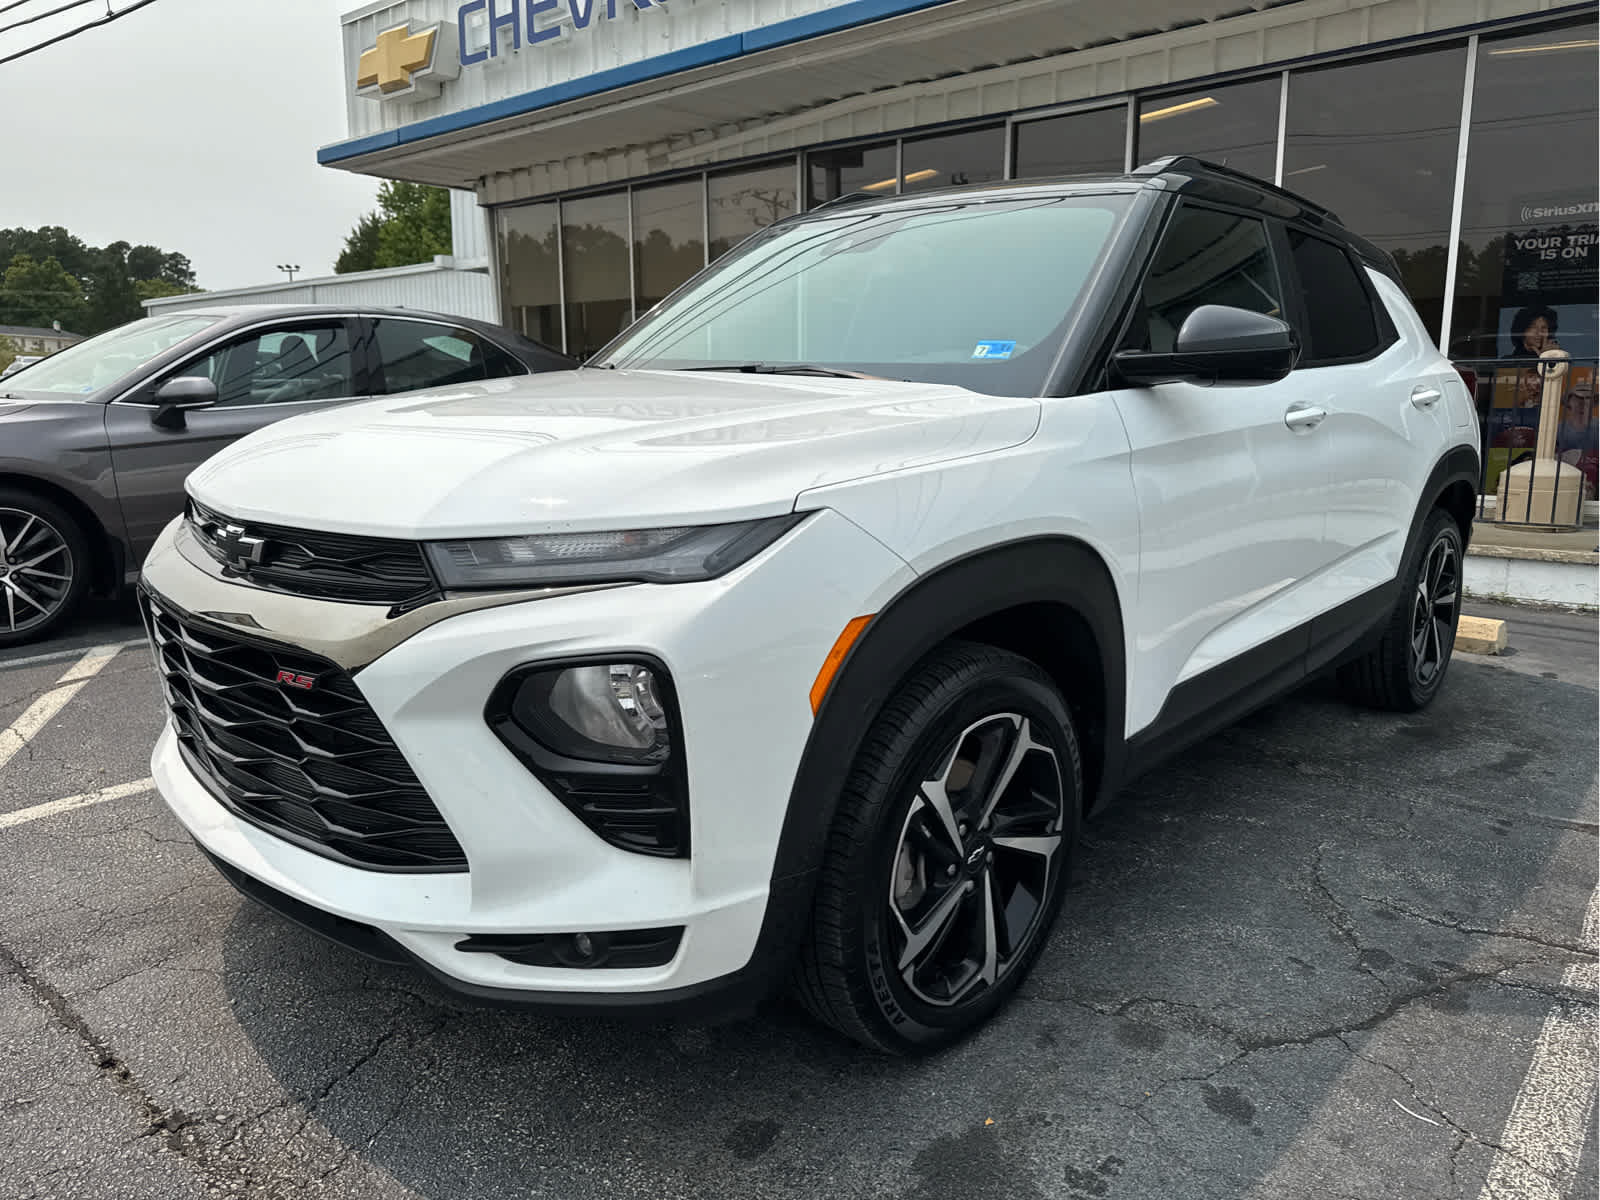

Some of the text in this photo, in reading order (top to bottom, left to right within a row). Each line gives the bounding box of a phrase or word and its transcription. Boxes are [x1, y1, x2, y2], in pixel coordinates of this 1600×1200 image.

[1514, 236, 1562, 250] YOUR
[1540, 246, 1589, 260] IS ON
[277, 670, 315, 690] RS
